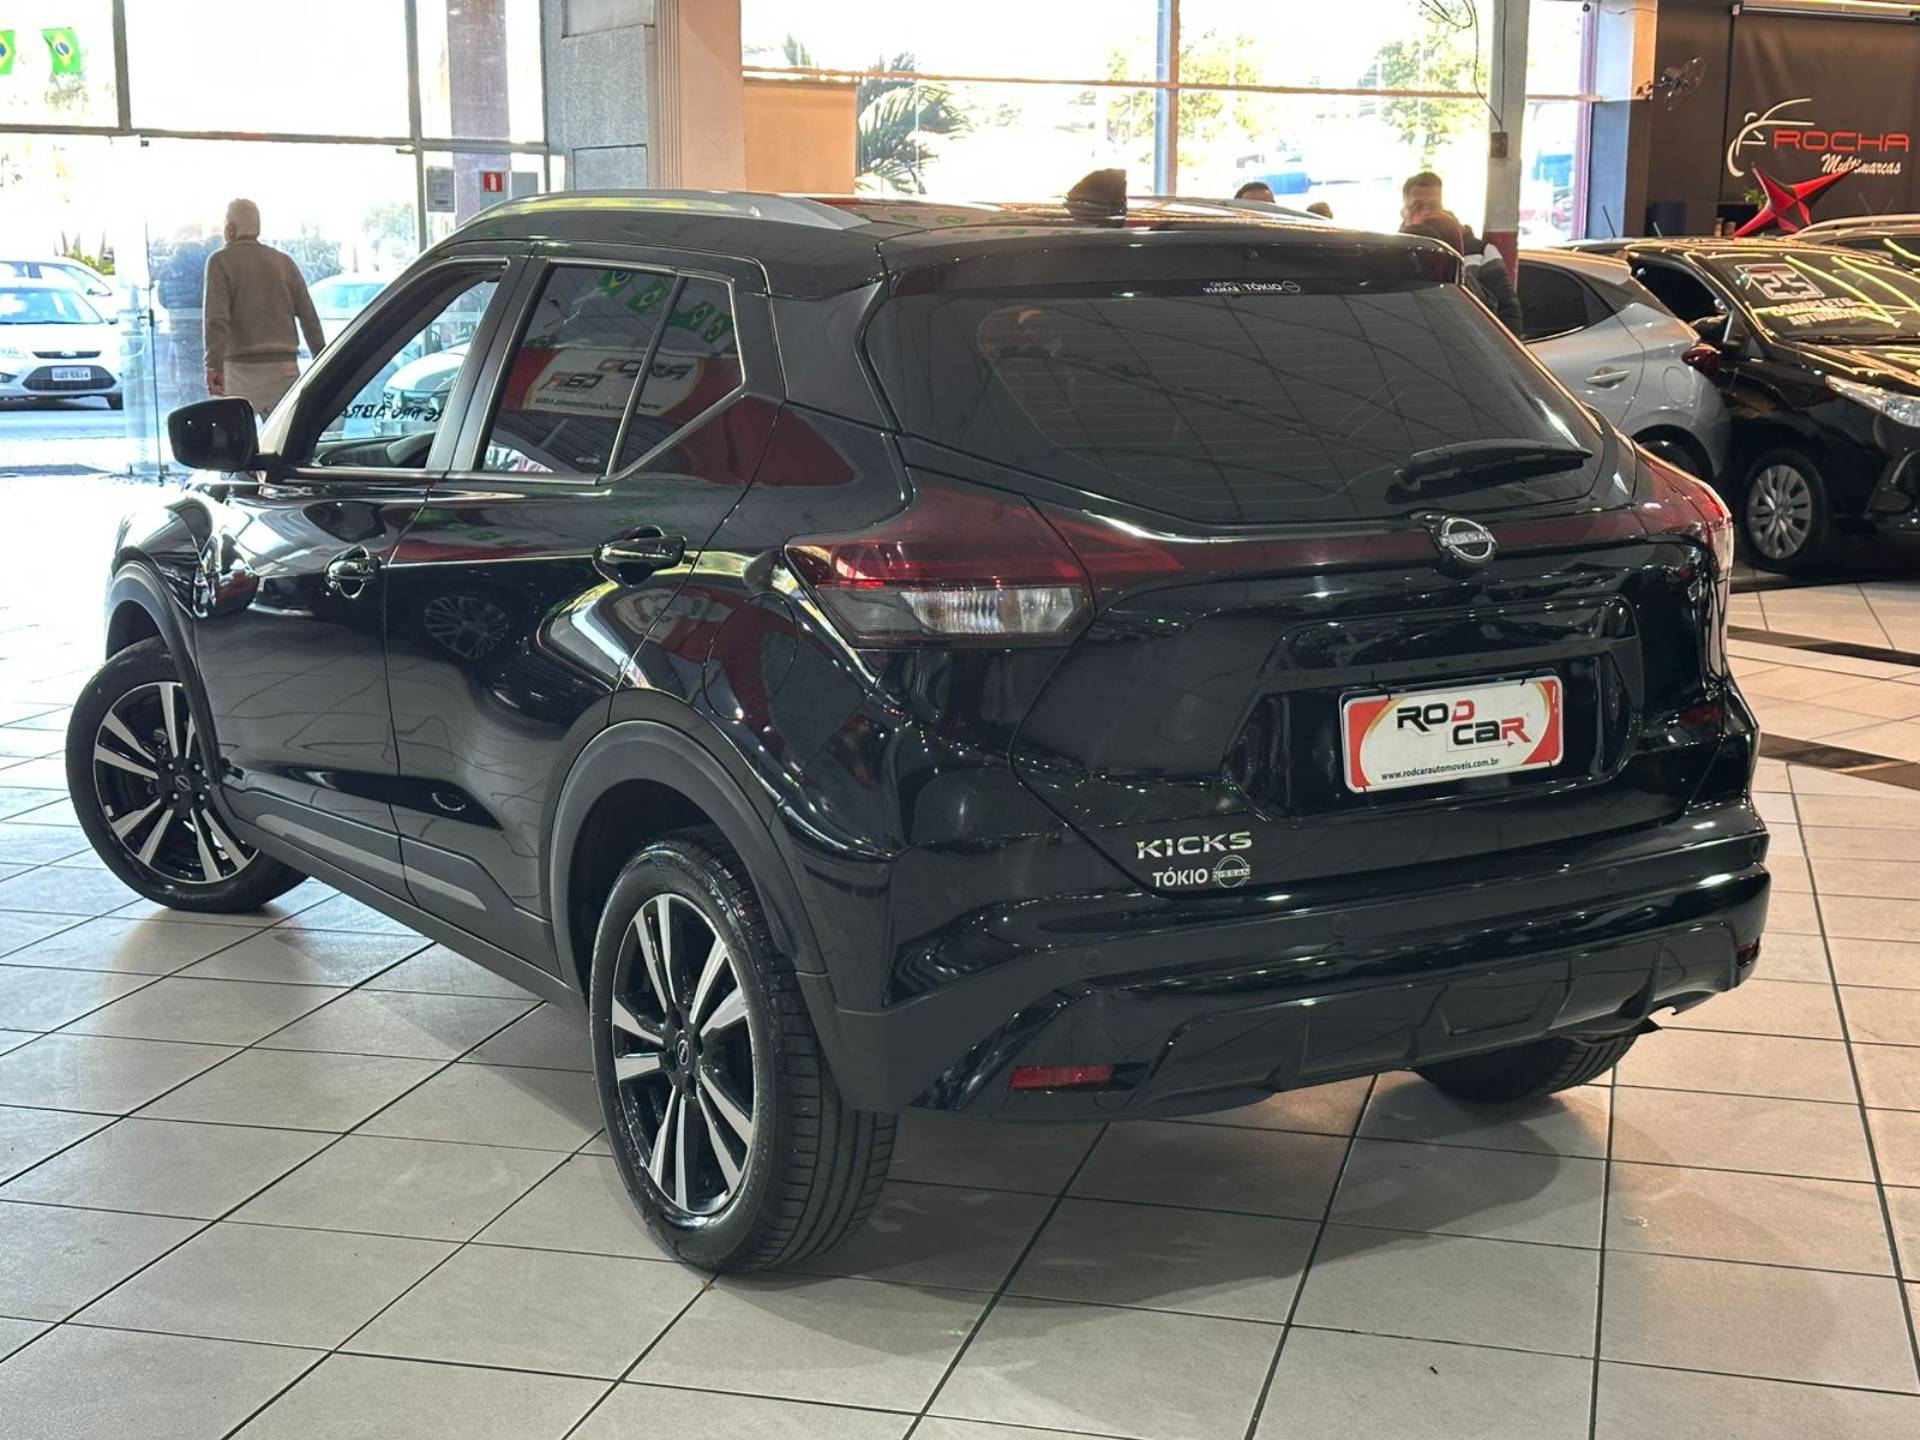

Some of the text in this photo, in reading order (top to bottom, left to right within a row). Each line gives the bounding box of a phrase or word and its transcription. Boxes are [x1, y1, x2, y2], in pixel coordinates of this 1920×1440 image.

[1773, 130, 1909, 152] ROCHA
[1821, 153, 1901, 175] Multimarcas
[1397, 699, 1475, 732] ROD
[1381, 757, 1499, 781] www.rodcarautomoveis.com.br
[1136, 830, 1252, 860] KICKS
[1152, 866, 1208, 888] TÓKIO
